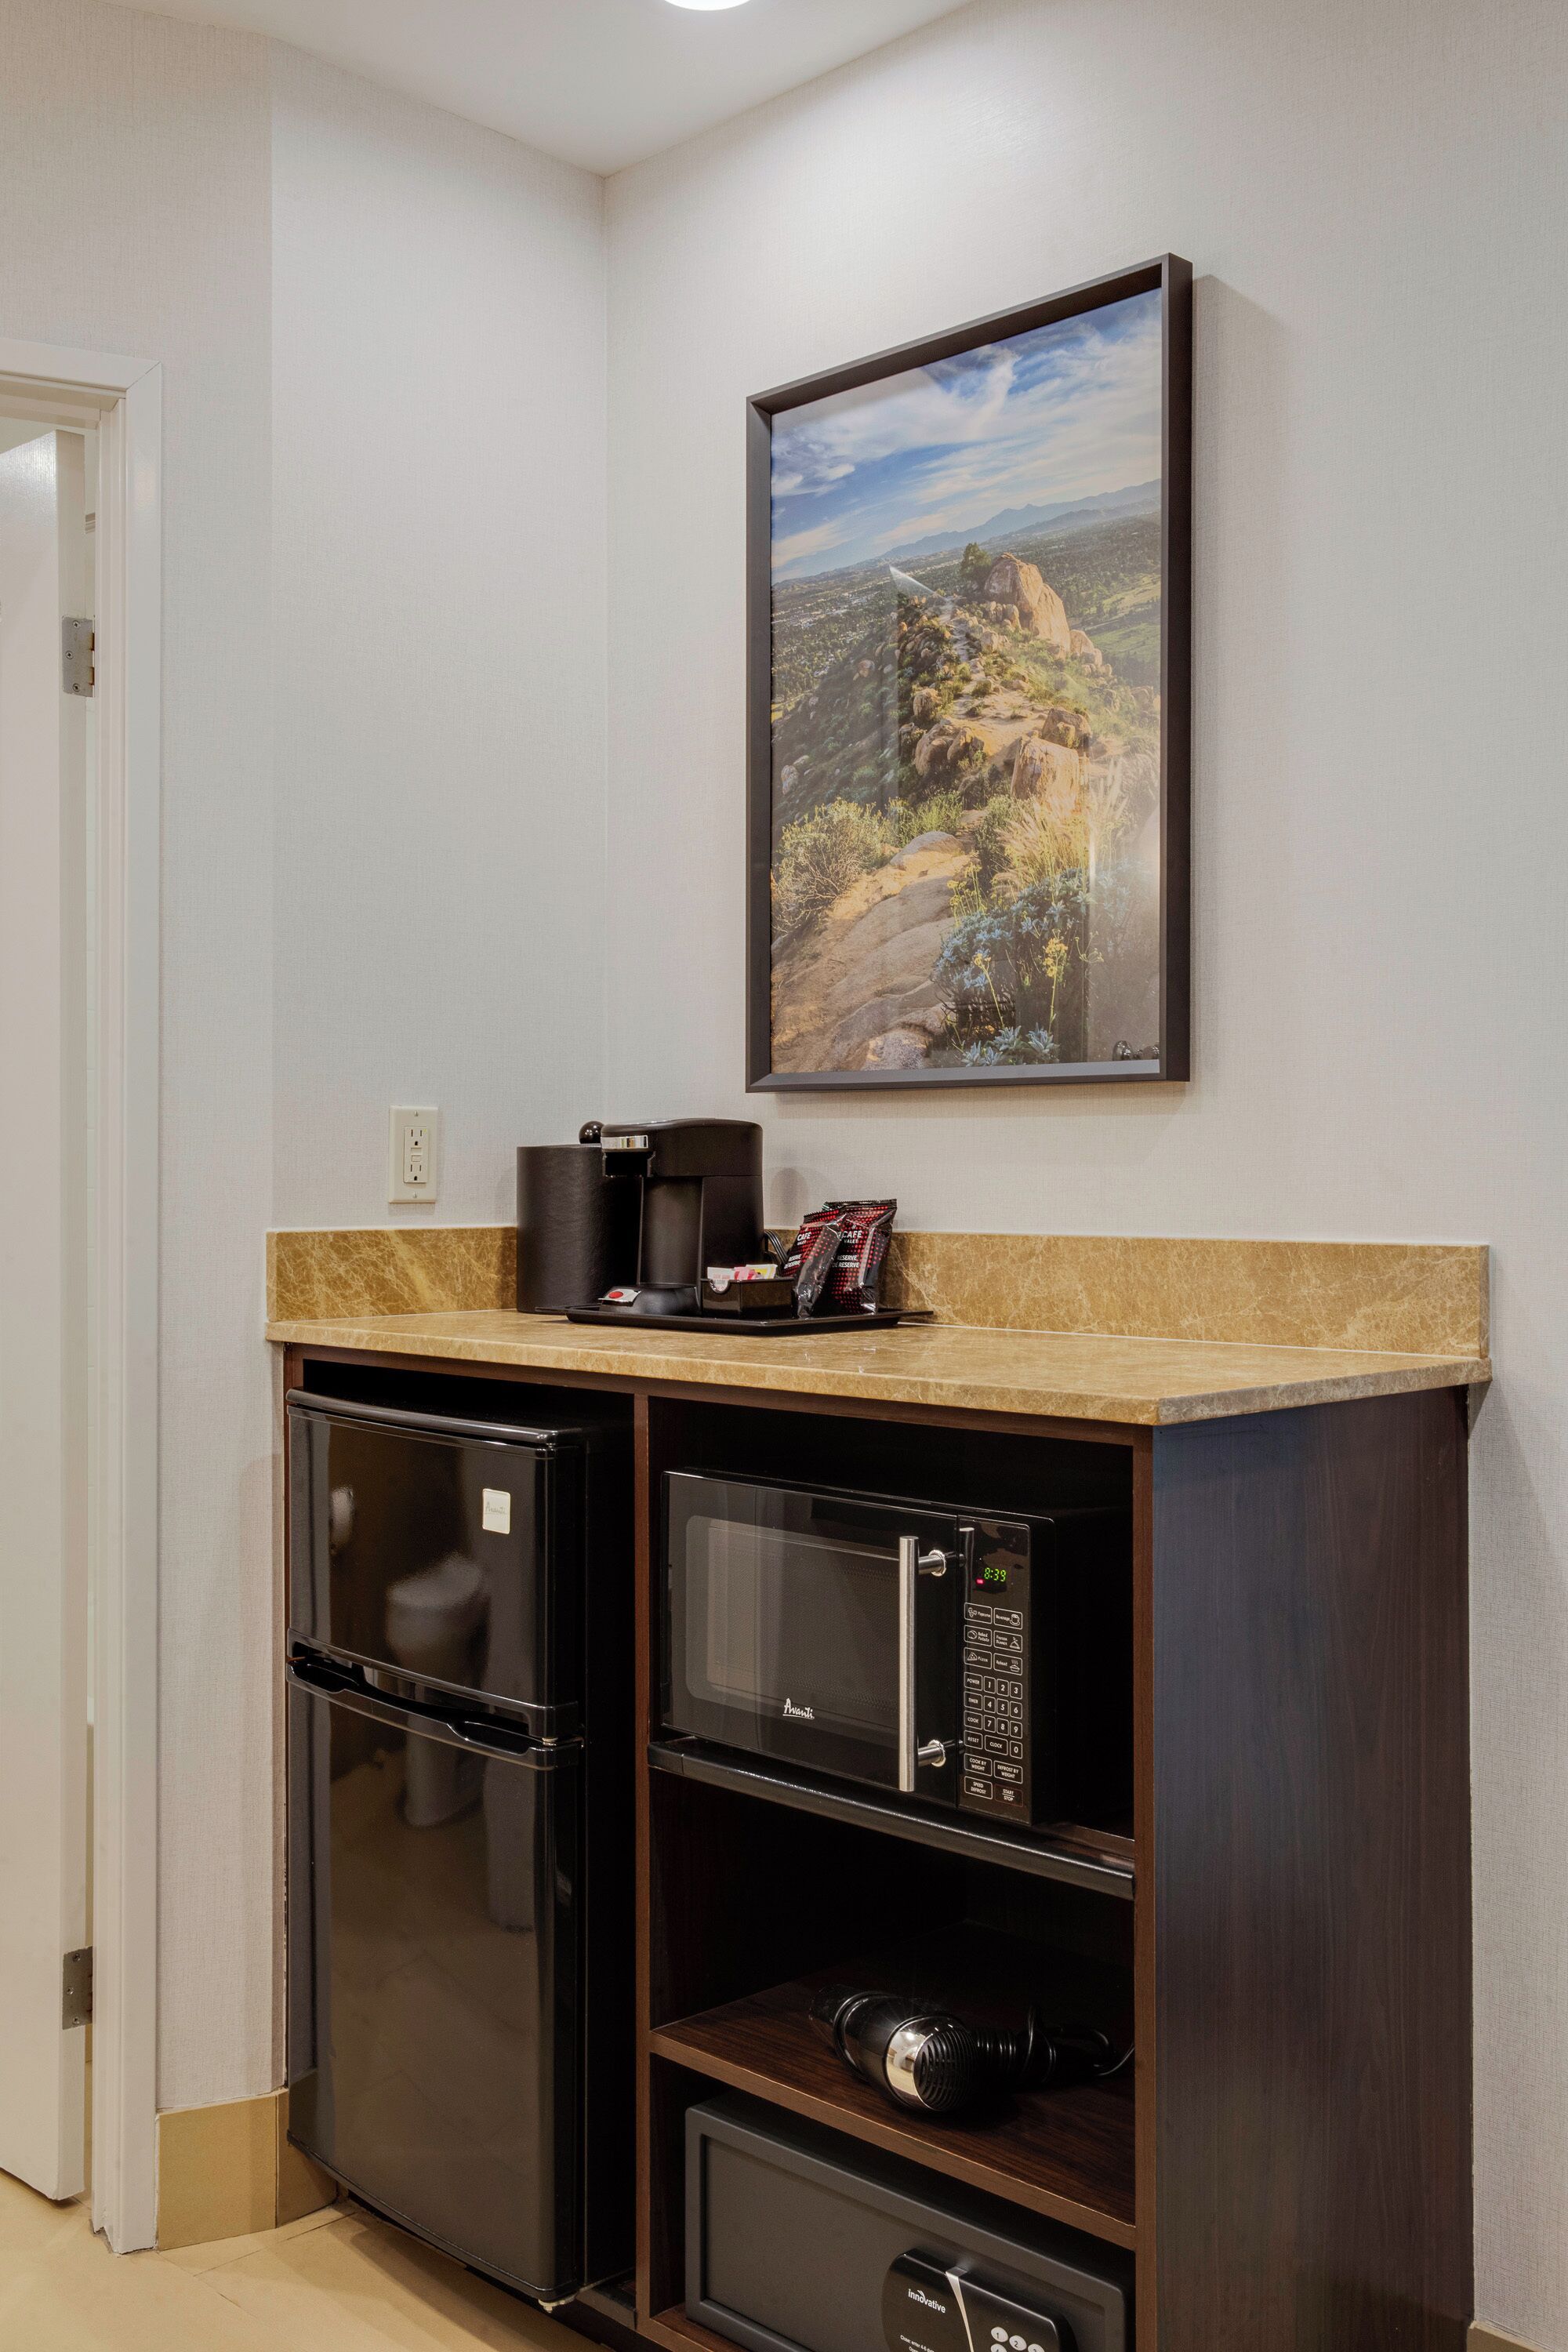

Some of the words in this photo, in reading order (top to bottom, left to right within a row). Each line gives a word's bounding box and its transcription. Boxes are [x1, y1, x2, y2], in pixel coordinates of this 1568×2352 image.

[985, 1567, 1007, 1582] 8:39
[783, 1697, 815, 1719] Avanti
[997, 1764, 1013, 1773] DEFROST
[1001, 1770, 1015, 1779] WEIGHT
[971, 1786, 986, 1795] DEFROST
[908, 2288, 946, 2314] innovative
